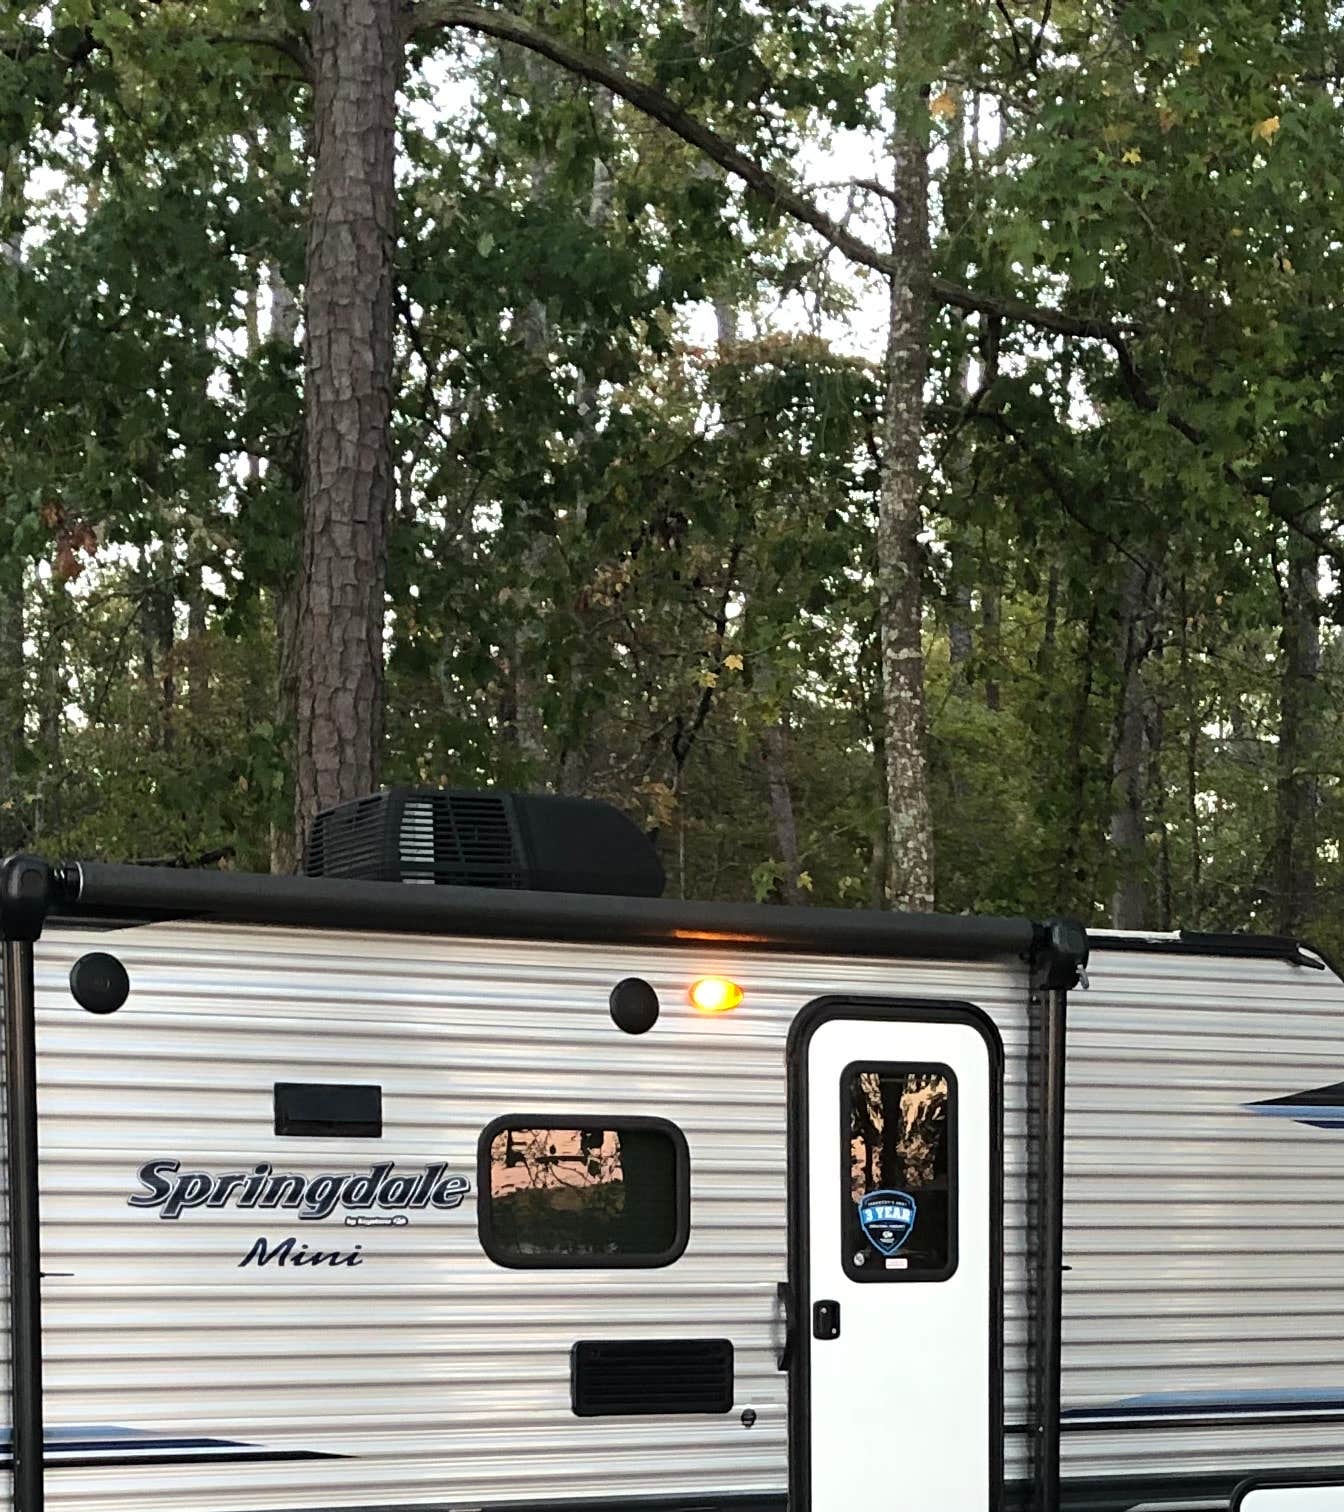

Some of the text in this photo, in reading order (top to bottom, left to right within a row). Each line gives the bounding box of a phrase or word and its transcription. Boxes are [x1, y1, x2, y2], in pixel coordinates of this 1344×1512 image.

[127, 1158, 472, 1220] Springdale
[864, 1206, 912, 1221] 3 YEAR
[238, 1237, 364, 1267] Mini
